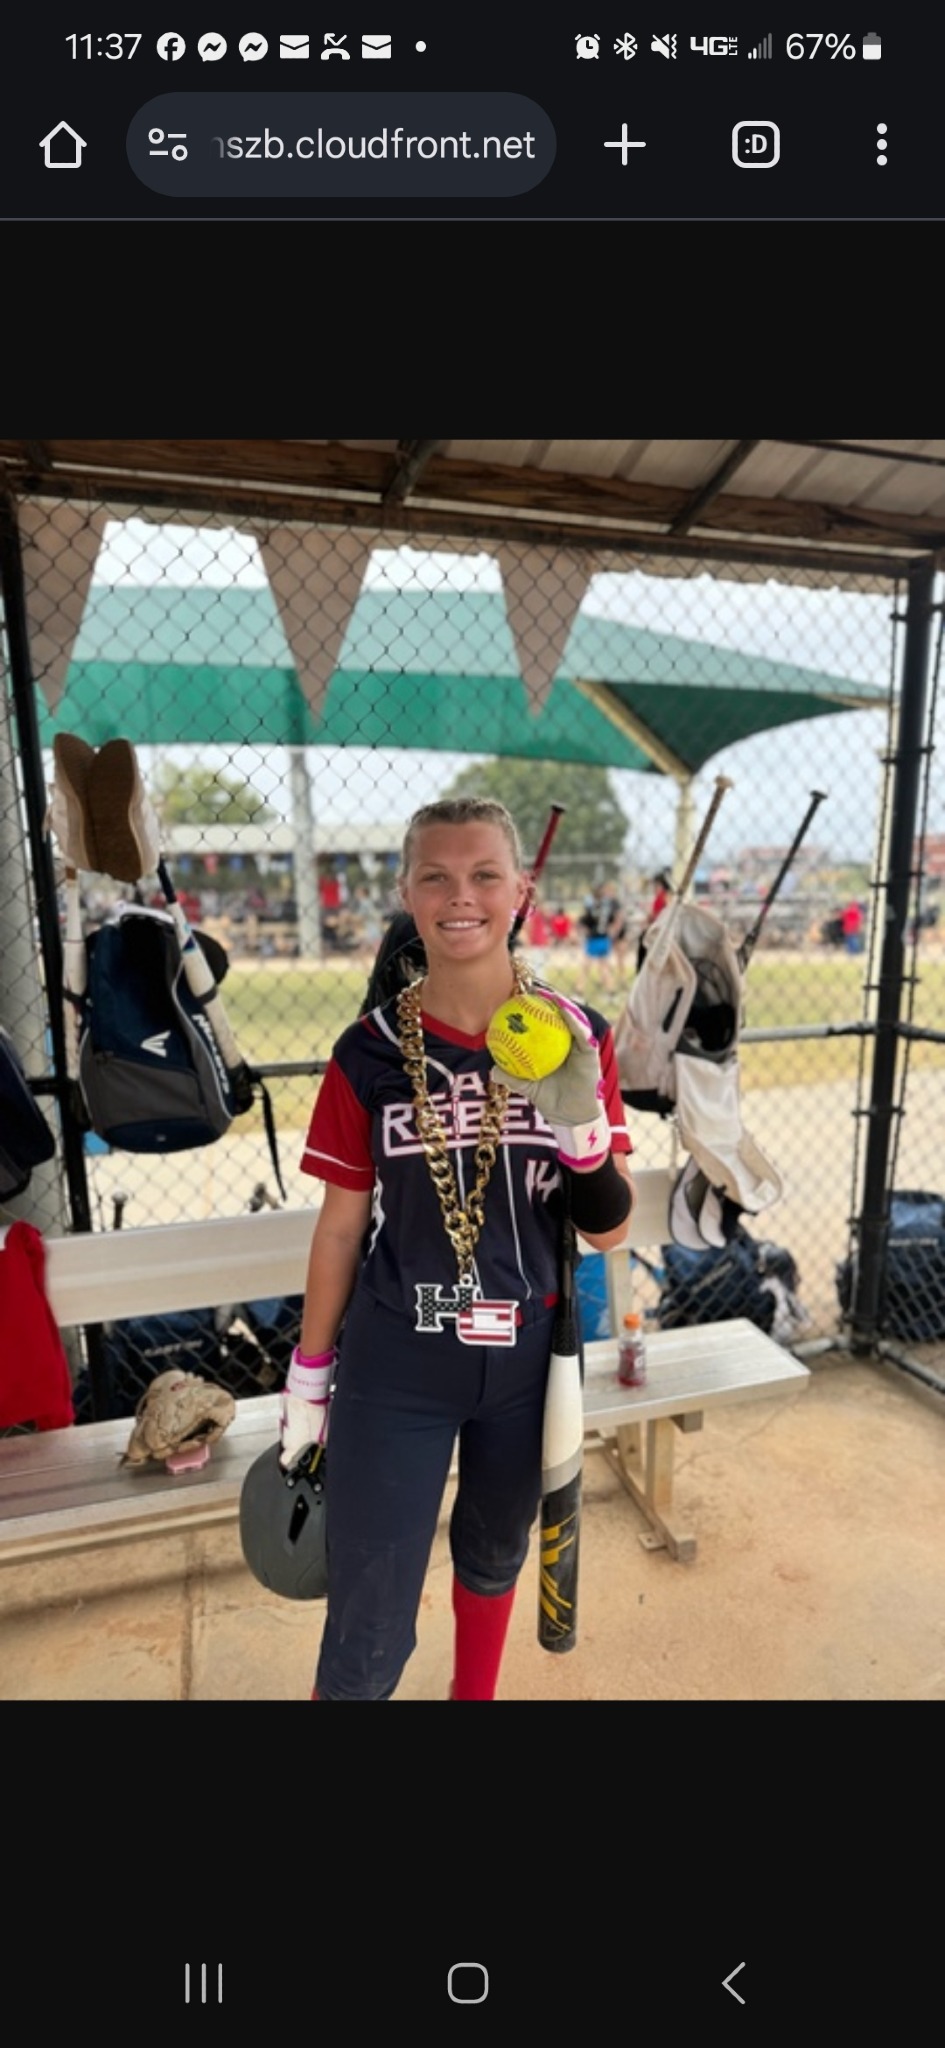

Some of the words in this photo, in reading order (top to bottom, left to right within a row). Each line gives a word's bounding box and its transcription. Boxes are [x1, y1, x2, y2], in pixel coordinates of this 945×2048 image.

[65, 33, 142, 60] 11:37
[690, 36, 729, 56] 4G
[786, 32, 856, 60] 67%
